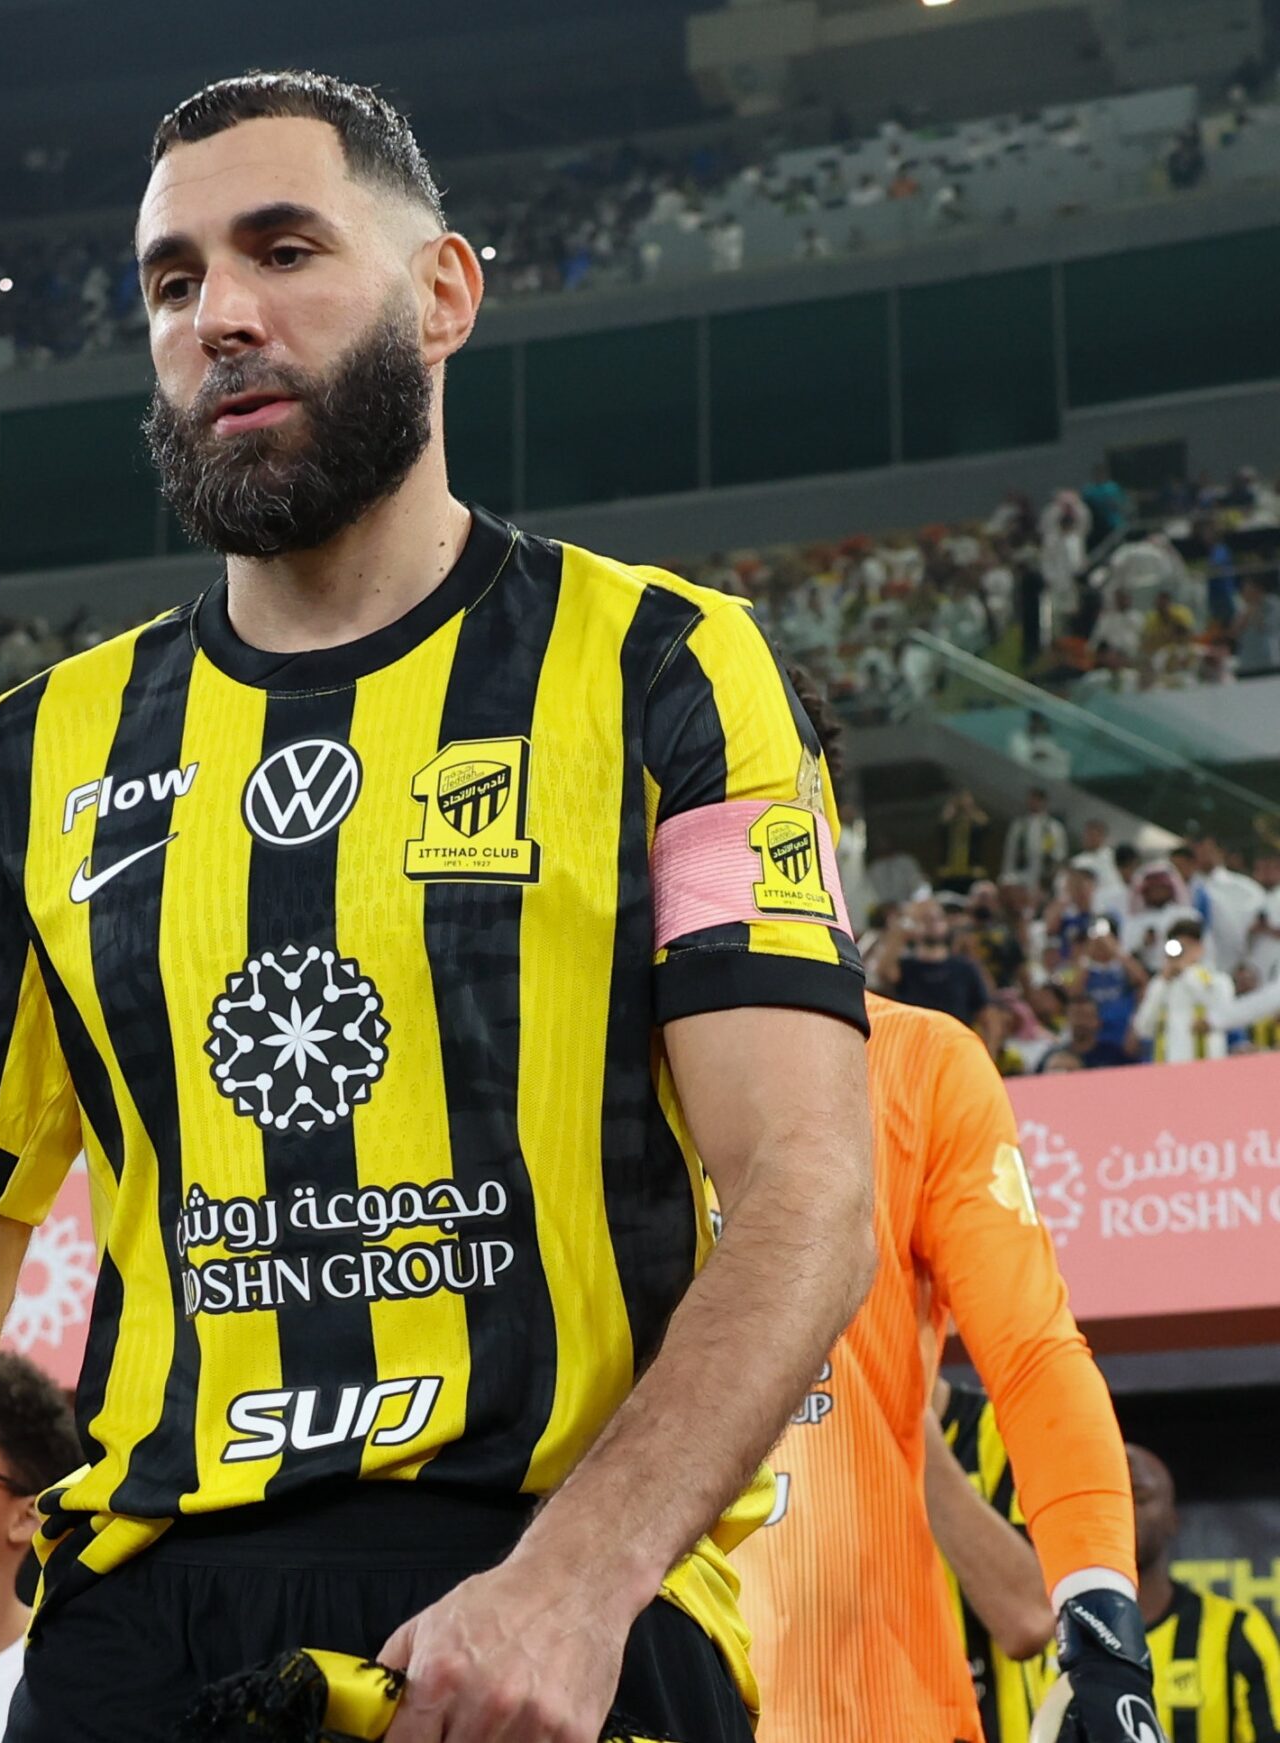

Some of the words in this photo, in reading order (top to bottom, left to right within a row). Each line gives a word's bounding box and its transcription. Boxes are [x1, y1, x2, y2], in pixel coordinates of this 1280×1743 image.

[62, 762, 199, 834] Flow
[418, 847, 477, 859] ITTIHAD
[482, 847, 519, 859] CLUB
[764, 889, 803, 900] ITTIHAD
[1096, 1130, 1239, 1191] روشن
[289, 1180, 507, 1239] مجموعة
[1099, 1187, 1263, 1239] ROSHN
[322, 1240, 515, 1300] GROUP
